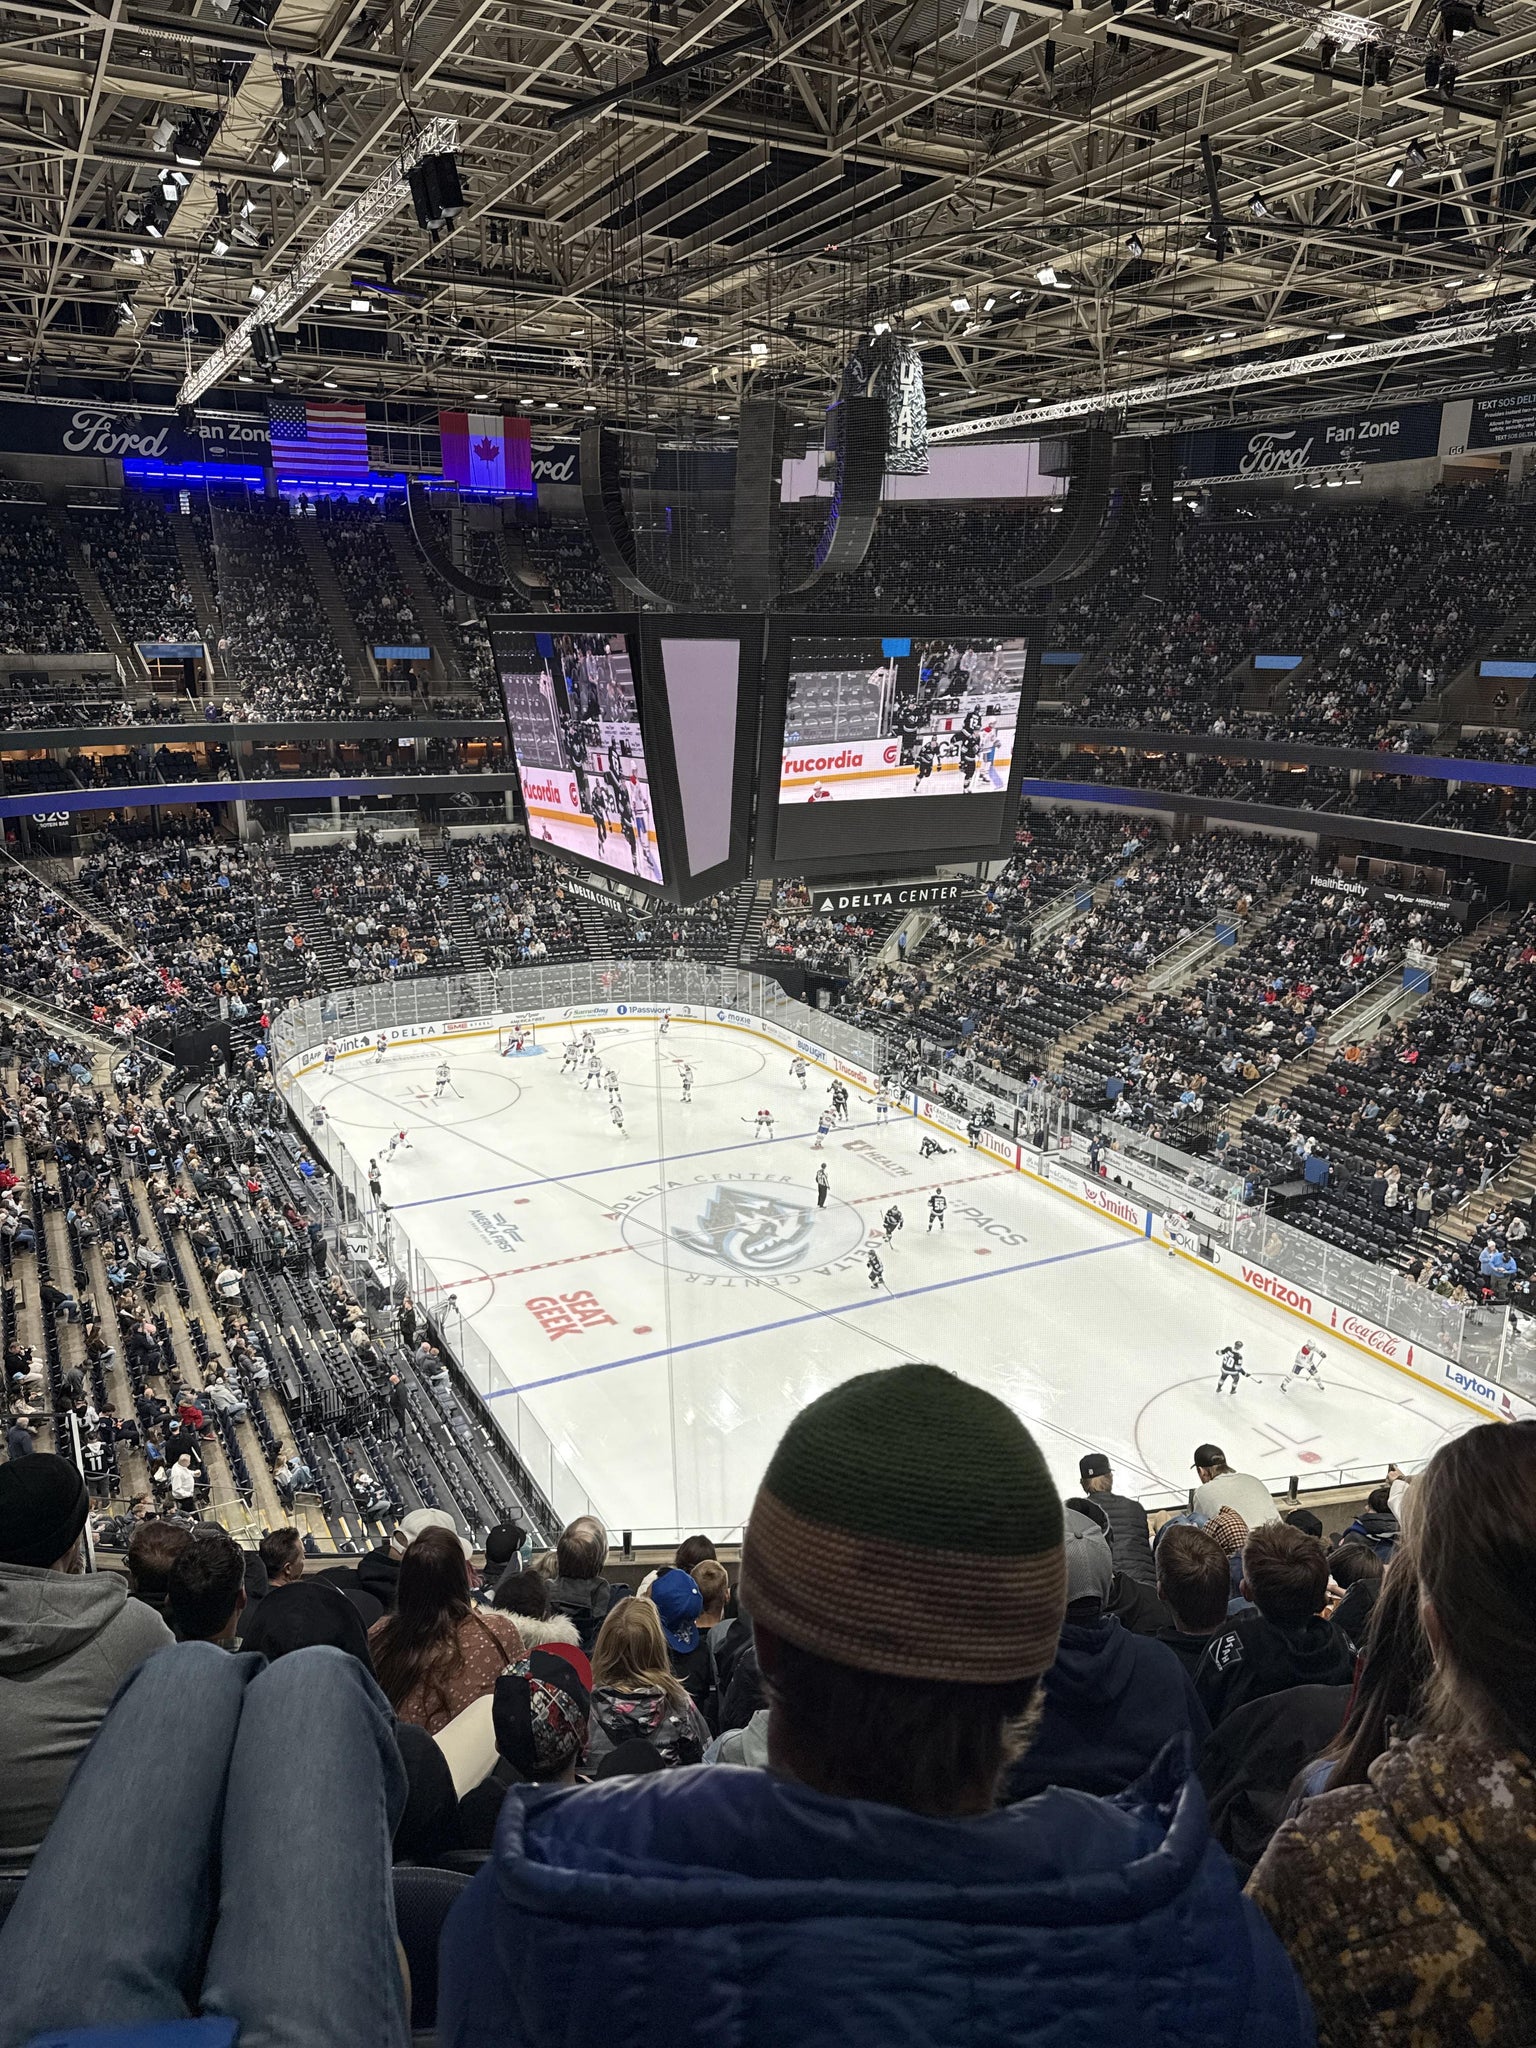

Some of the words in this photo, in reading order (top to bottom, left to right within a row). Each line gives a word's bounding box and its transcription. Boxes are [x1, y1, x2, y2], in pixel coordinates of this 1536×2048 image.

[896, 362, 915, 449] UTAH
[1477, 400, 1497, 410] TEXT
[1498, 397, 1516, 407] SOS
[1516, 394, 1536, 405] DELT
[62, 410, 169, 457] Ford
[195, 425, 224, 439] an
[227, 424, 271, 442] Zone
[1325, 426, 1355, 443] Fan
[1358, 420, 1400, 440] Zone
[1239, 430, 1315, 474] Ford
[783, 750, 863, 774] rucordia
[573, 884, 596, 902] DELTA
[596, 893, 622, 913] CENTER
[839, 893, 892, 909] DELTA
[900, 887, 957, 903] CENTER
[1310, 875, 1368, 897] HealthEquity
[392, 1025, 436, 1039] DELTA
[983, 1132, 1012, 1158] Tinto
[613, 1180, 683, 1211] DELTA
[694, 1173, 792, 1183] CENTER
[1099, 1191, 1138, 1225] Smith's
[468, 1209, 498, 1236] AMERICA
[492, 1231, 516, 1253] FIRST
[1241, 1266, 1312, 1315] verizon
[525, 1296, 584, 1342] GEEK
[559, 1290, 619, 1328] SEAT
[1446, 1364, 1496, 1401] Layton
[89, 1456, 102, 1471] 11
[1221, 1635, 1236, 1663] UTAH
